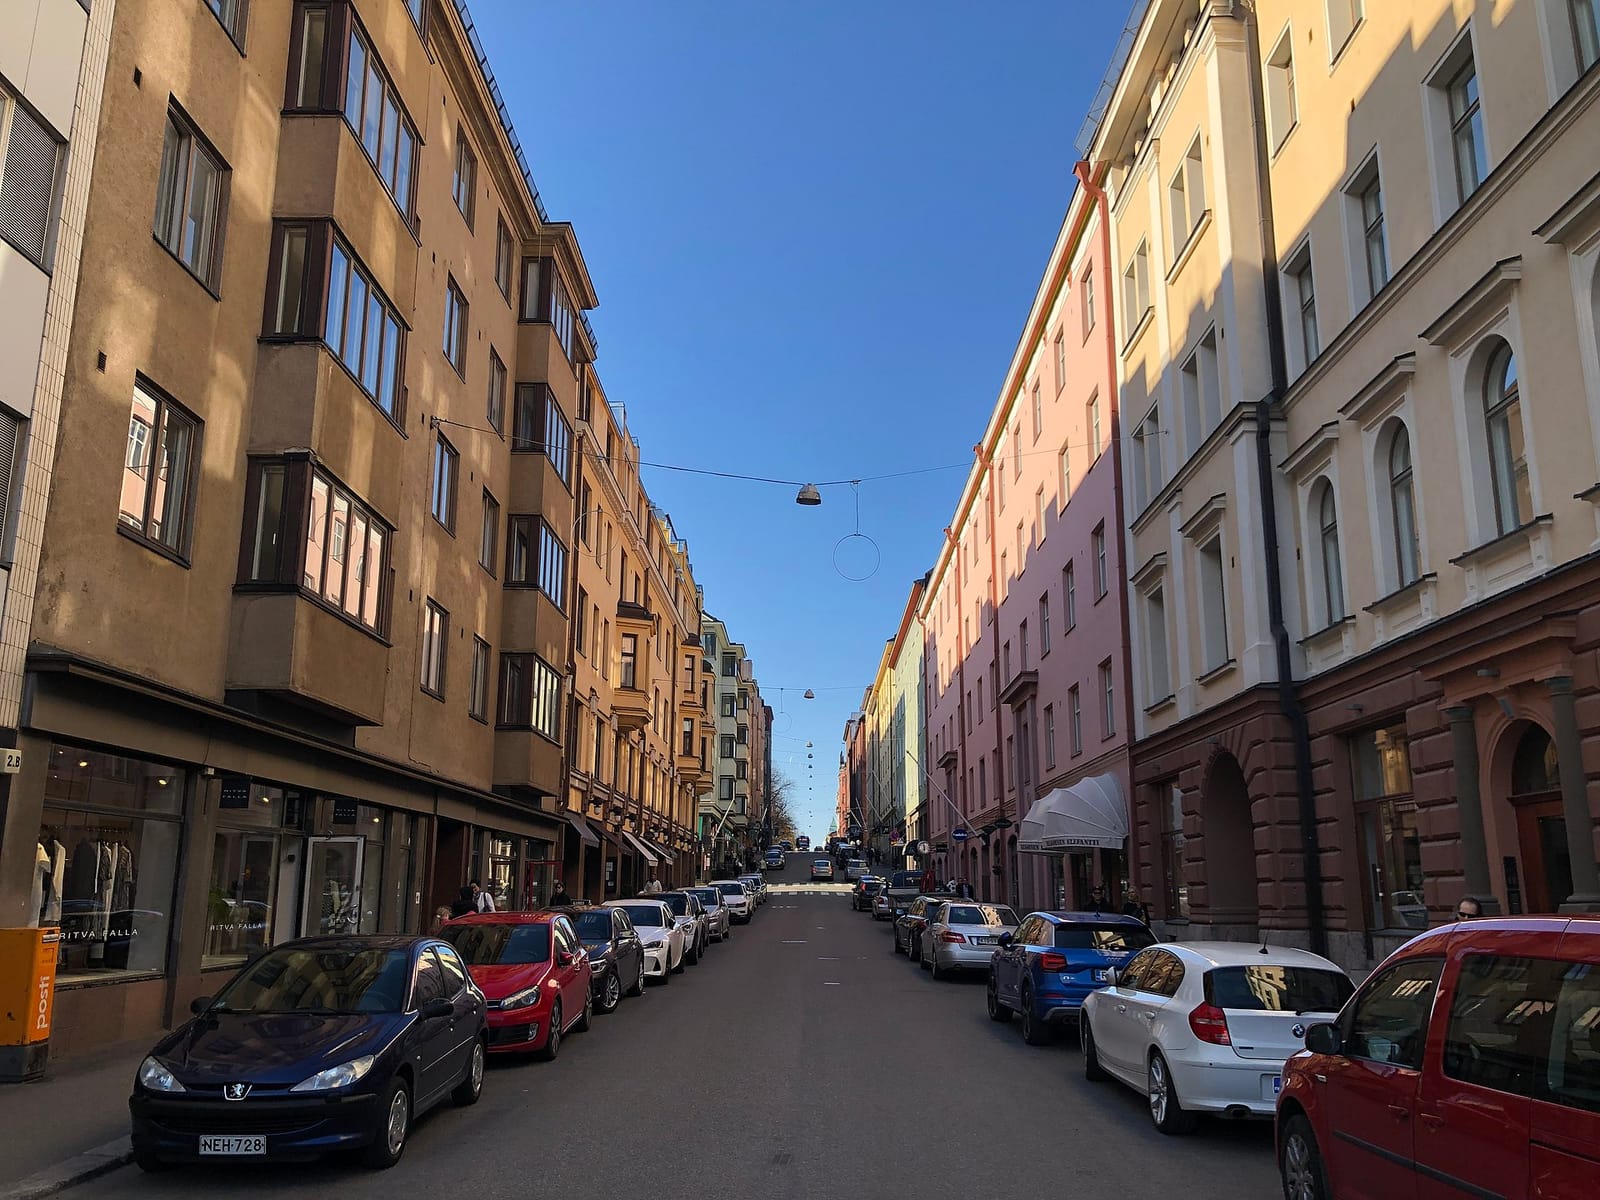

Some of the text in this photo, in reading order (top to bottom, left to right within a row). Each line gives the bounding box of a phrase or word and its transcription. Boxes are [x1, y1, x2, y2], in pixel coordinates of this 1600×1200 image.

[59, 928, 138, 940] RITVA FALLA
[37, 975, 50, 1030] posti
